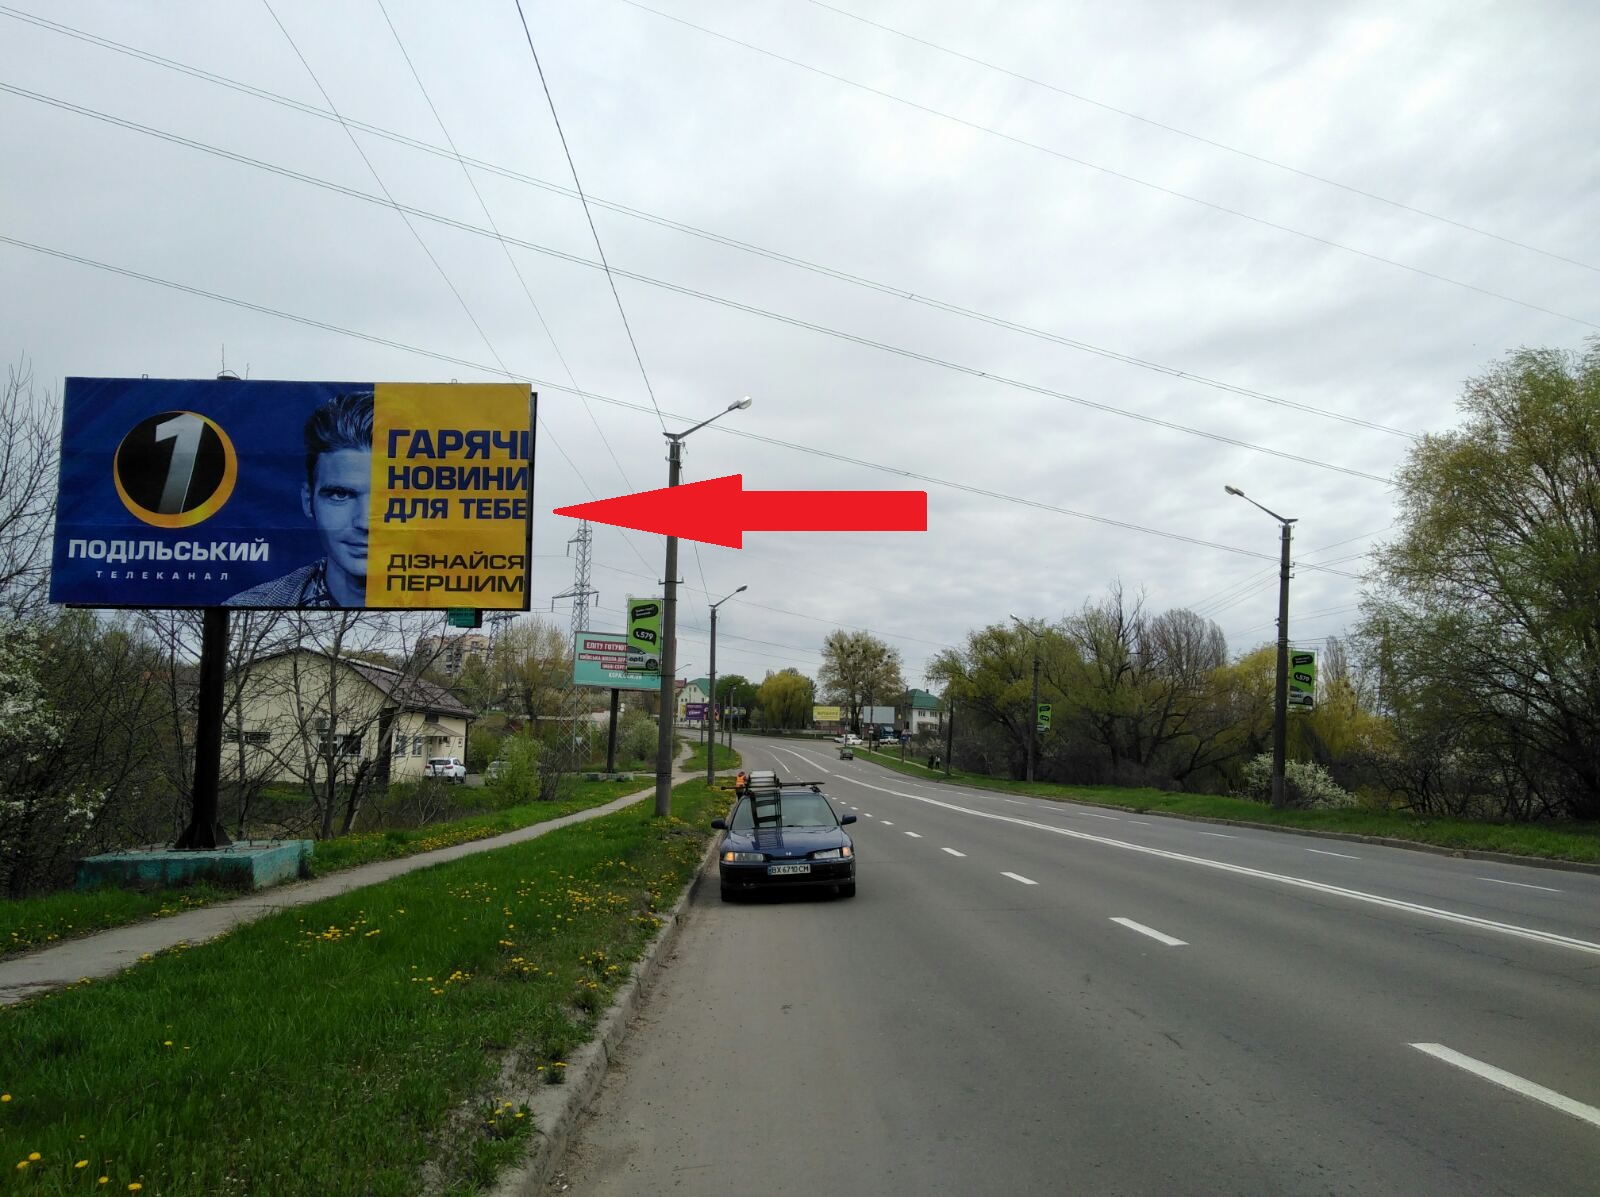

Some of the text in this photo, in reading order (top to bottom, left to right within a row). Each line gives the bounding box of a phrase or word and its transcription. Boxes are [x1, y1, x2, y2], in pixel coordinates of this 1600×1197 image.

[387, 429, 529, 460] ГАРЯЧІ
[155, 413, 205, 514] 1
[387, 466, 528, 491] НОВИНИ
[384, 498, 527, 523] ДЛЯ ТЕБЕ
[68, 538, 270, 563] ПОДІЛЬСЬКИЙ
[387, 551, 525, 572] ДІЗНАЙСЯ
[96, 570, 229, 581] ТЕЛЕКАНАЛ
[386, 575, 524, 592] ПЕРШИМ
[640, 631, 654, 640] 579
